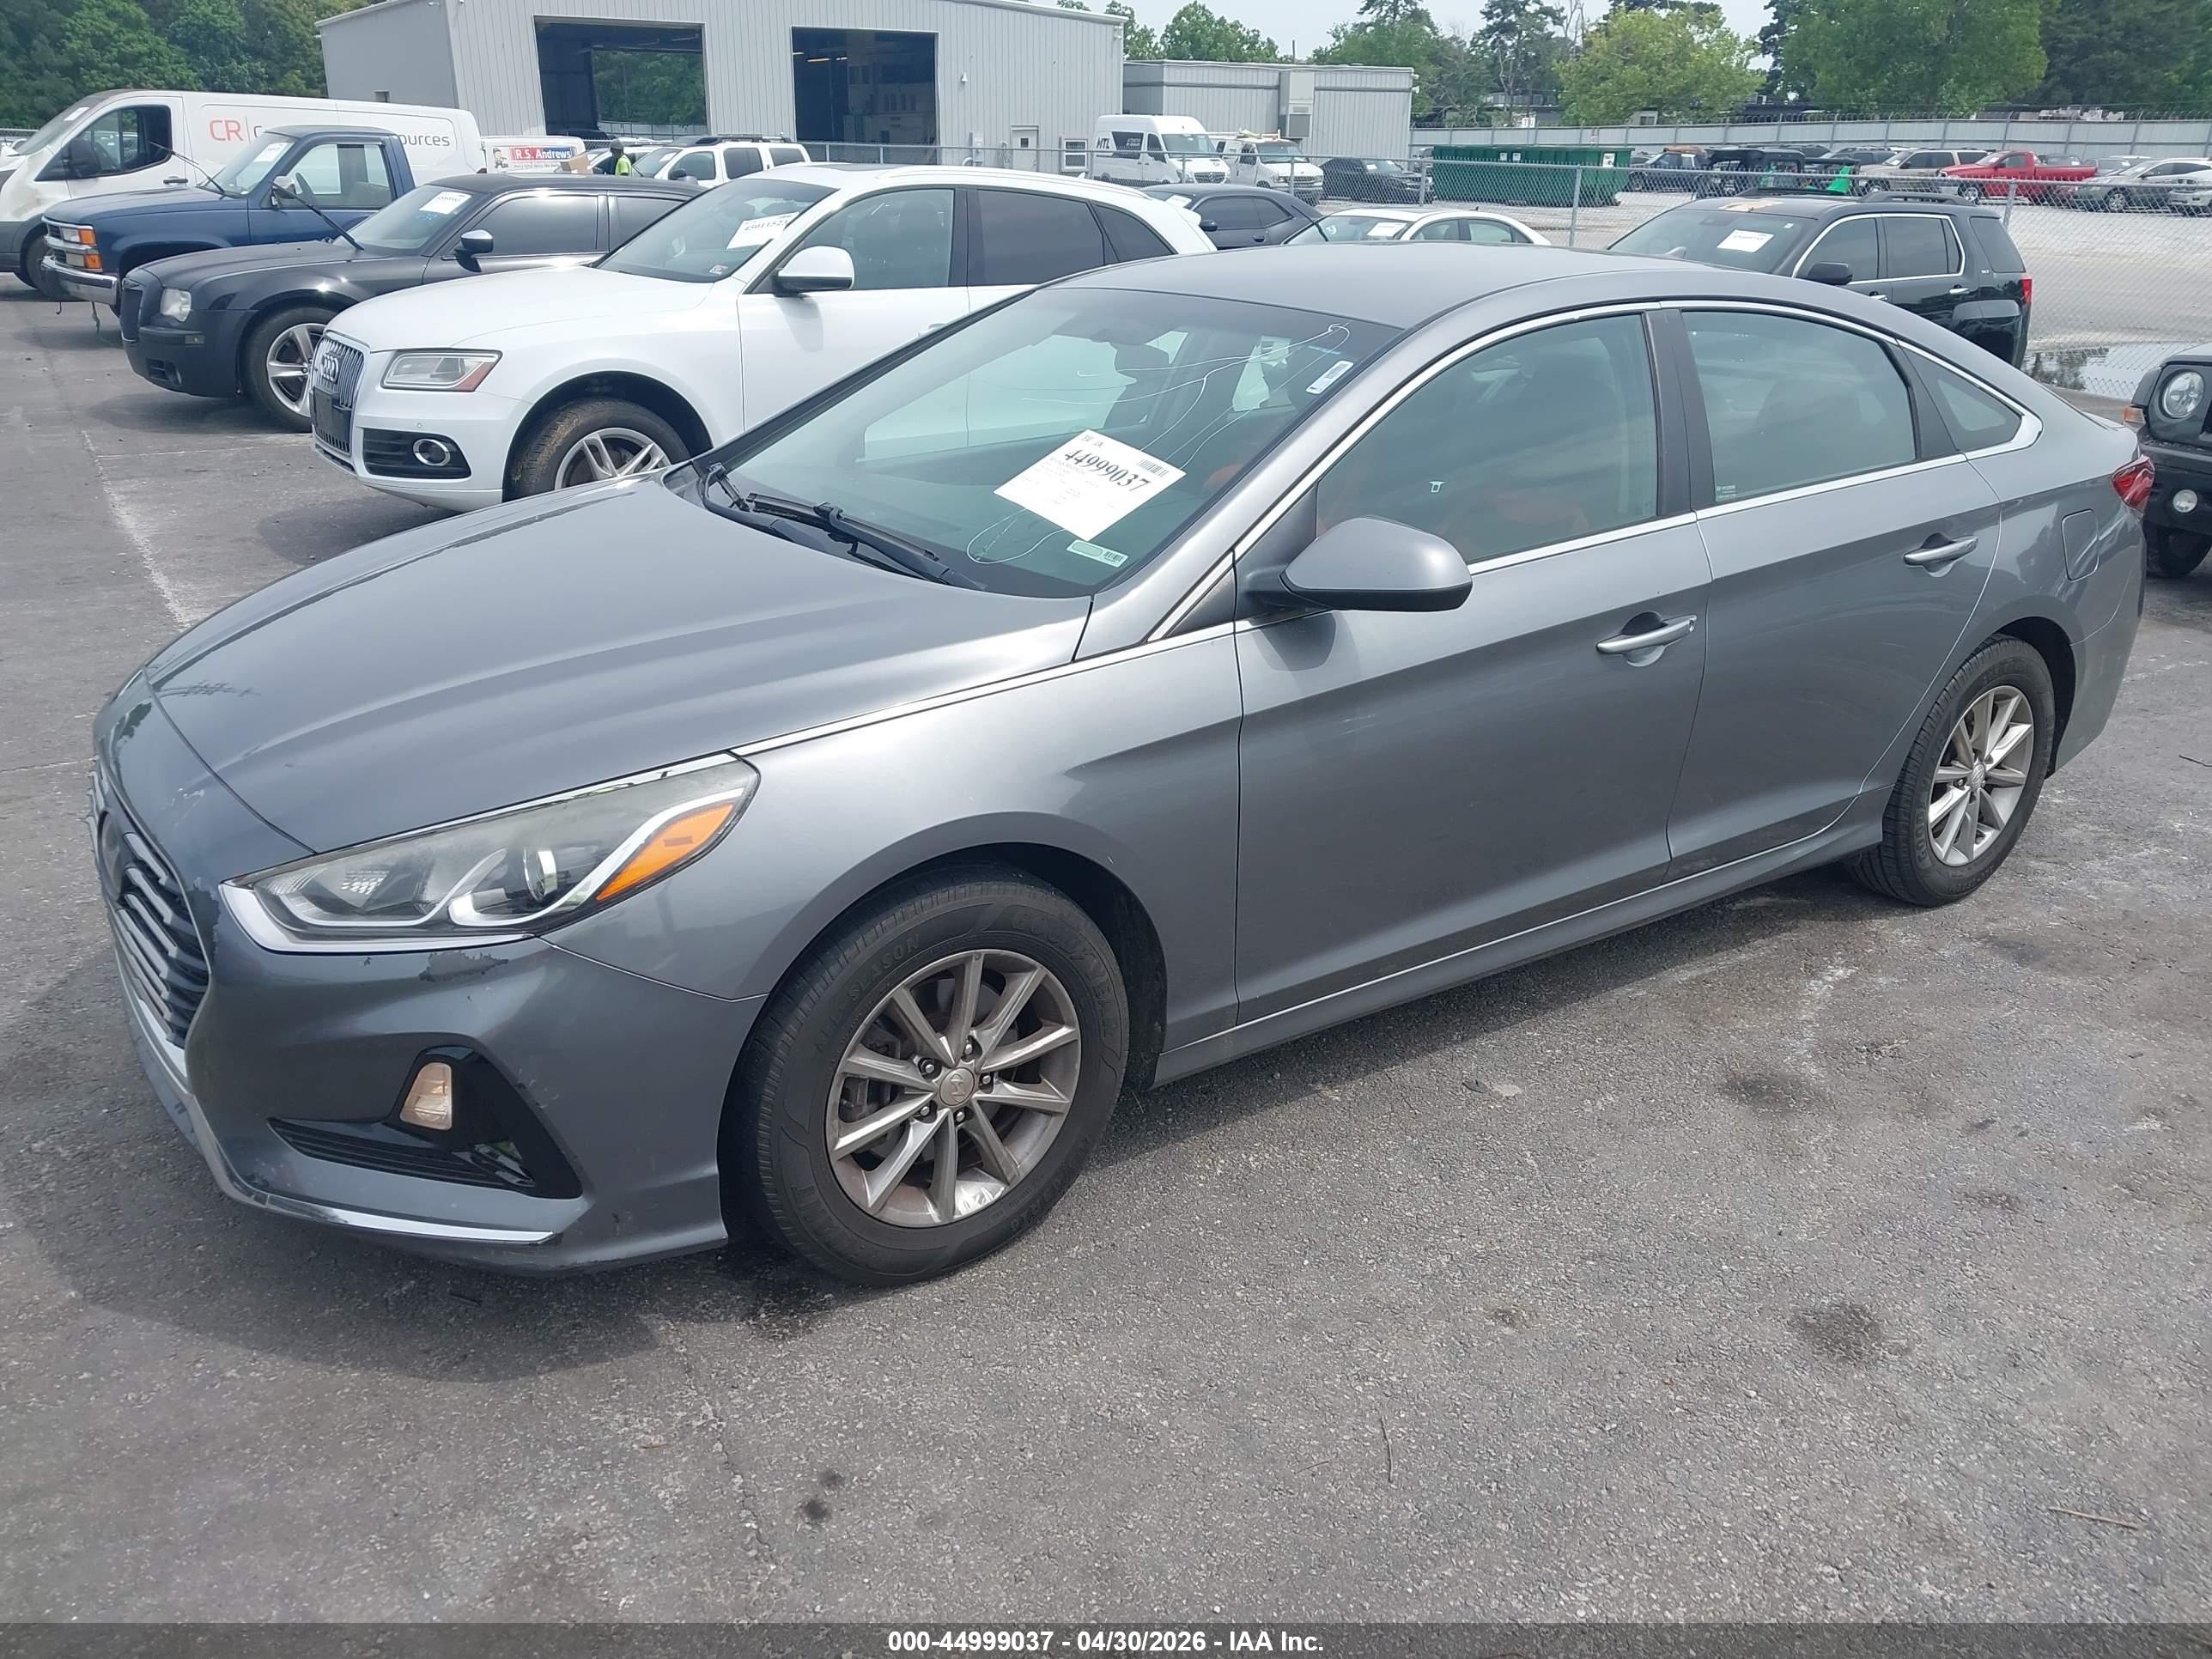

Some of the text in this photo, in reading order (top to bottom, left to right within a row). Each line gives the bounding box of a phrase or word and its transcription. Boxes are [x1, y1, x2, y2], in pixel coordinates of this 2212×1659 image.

[210, 119, 243, 141] CR
[398, 134, 450, 147] ources
[515, 148, 572, 160] R.S. Andrews
[1065, 449, 1152, 492] 44999037
